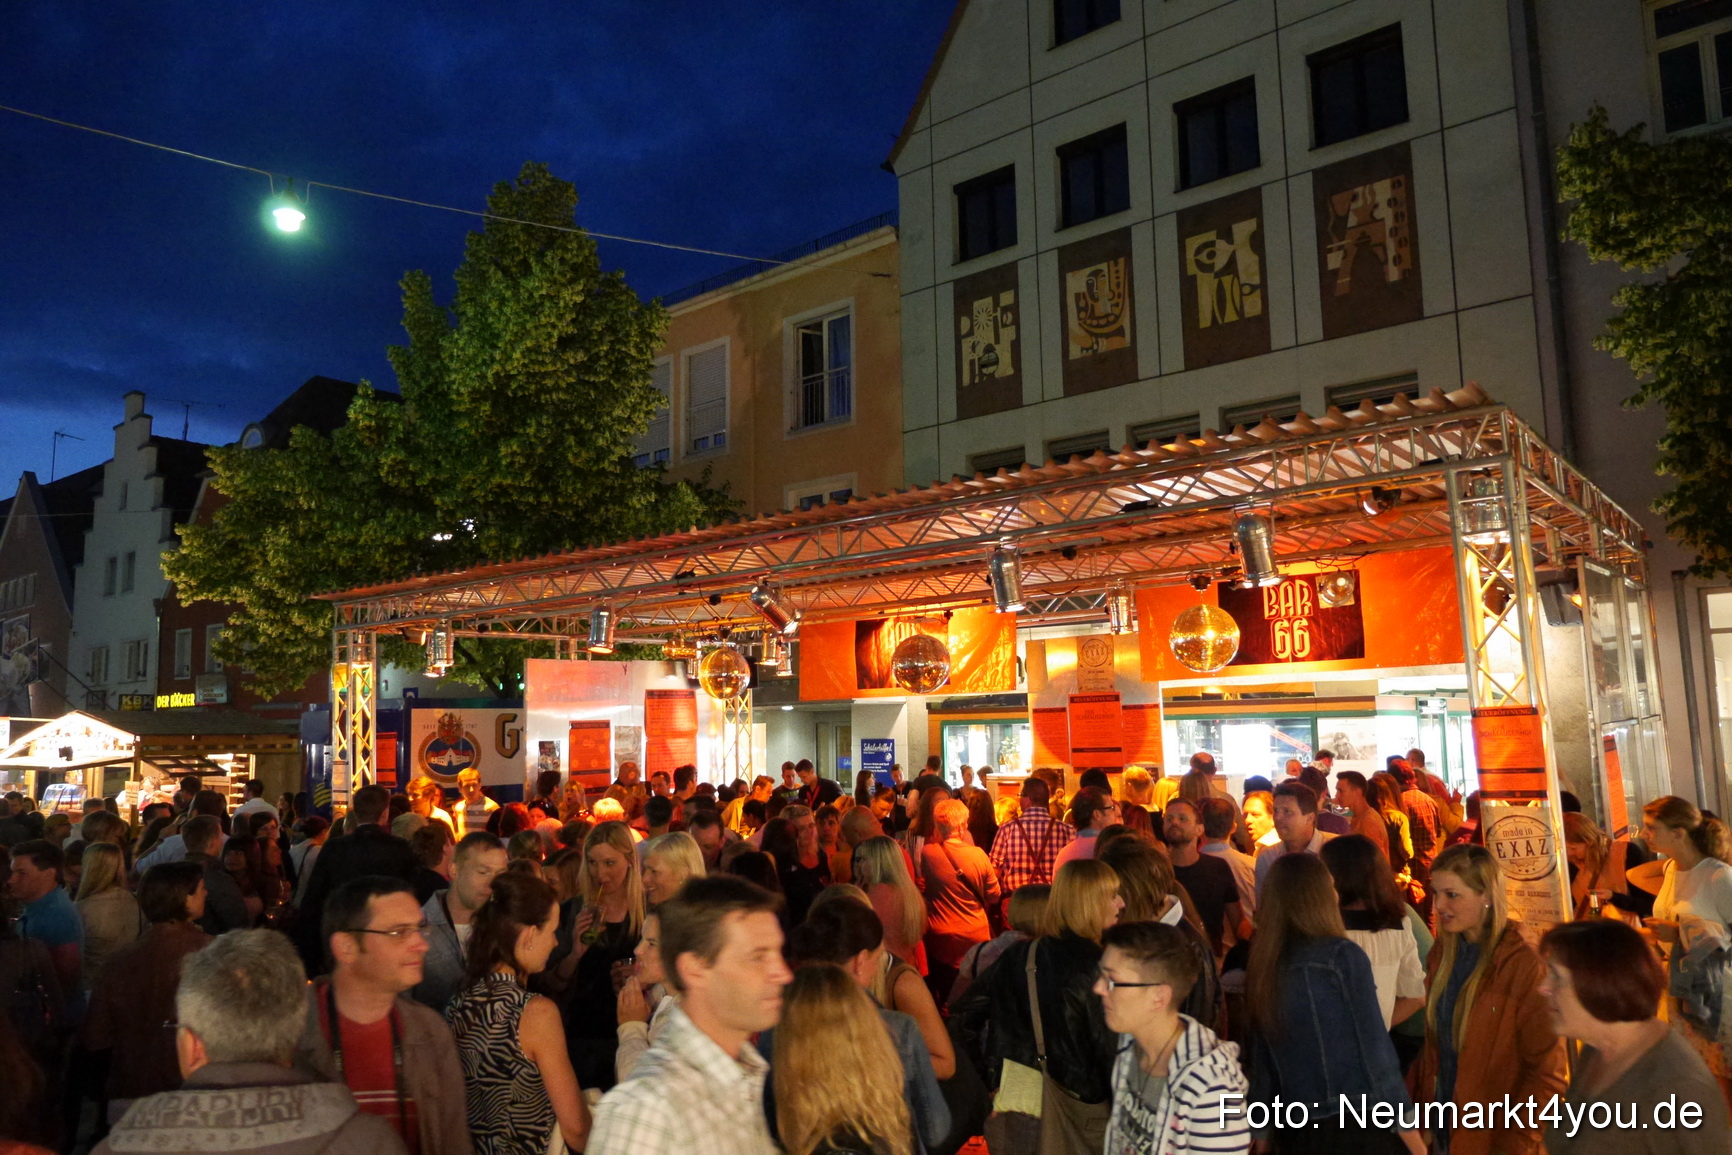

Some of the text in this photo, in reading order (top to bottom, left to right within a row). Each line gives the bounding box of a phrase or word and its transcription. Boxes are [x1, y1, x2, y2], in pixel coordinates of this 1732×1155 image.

[1262, 579, 1314, 620] BAR
[1270, 615, 1311, 659] 66
[156, 692, 196, 709] DER BÄCKER
[1502, 826, 1533, 838] made in
